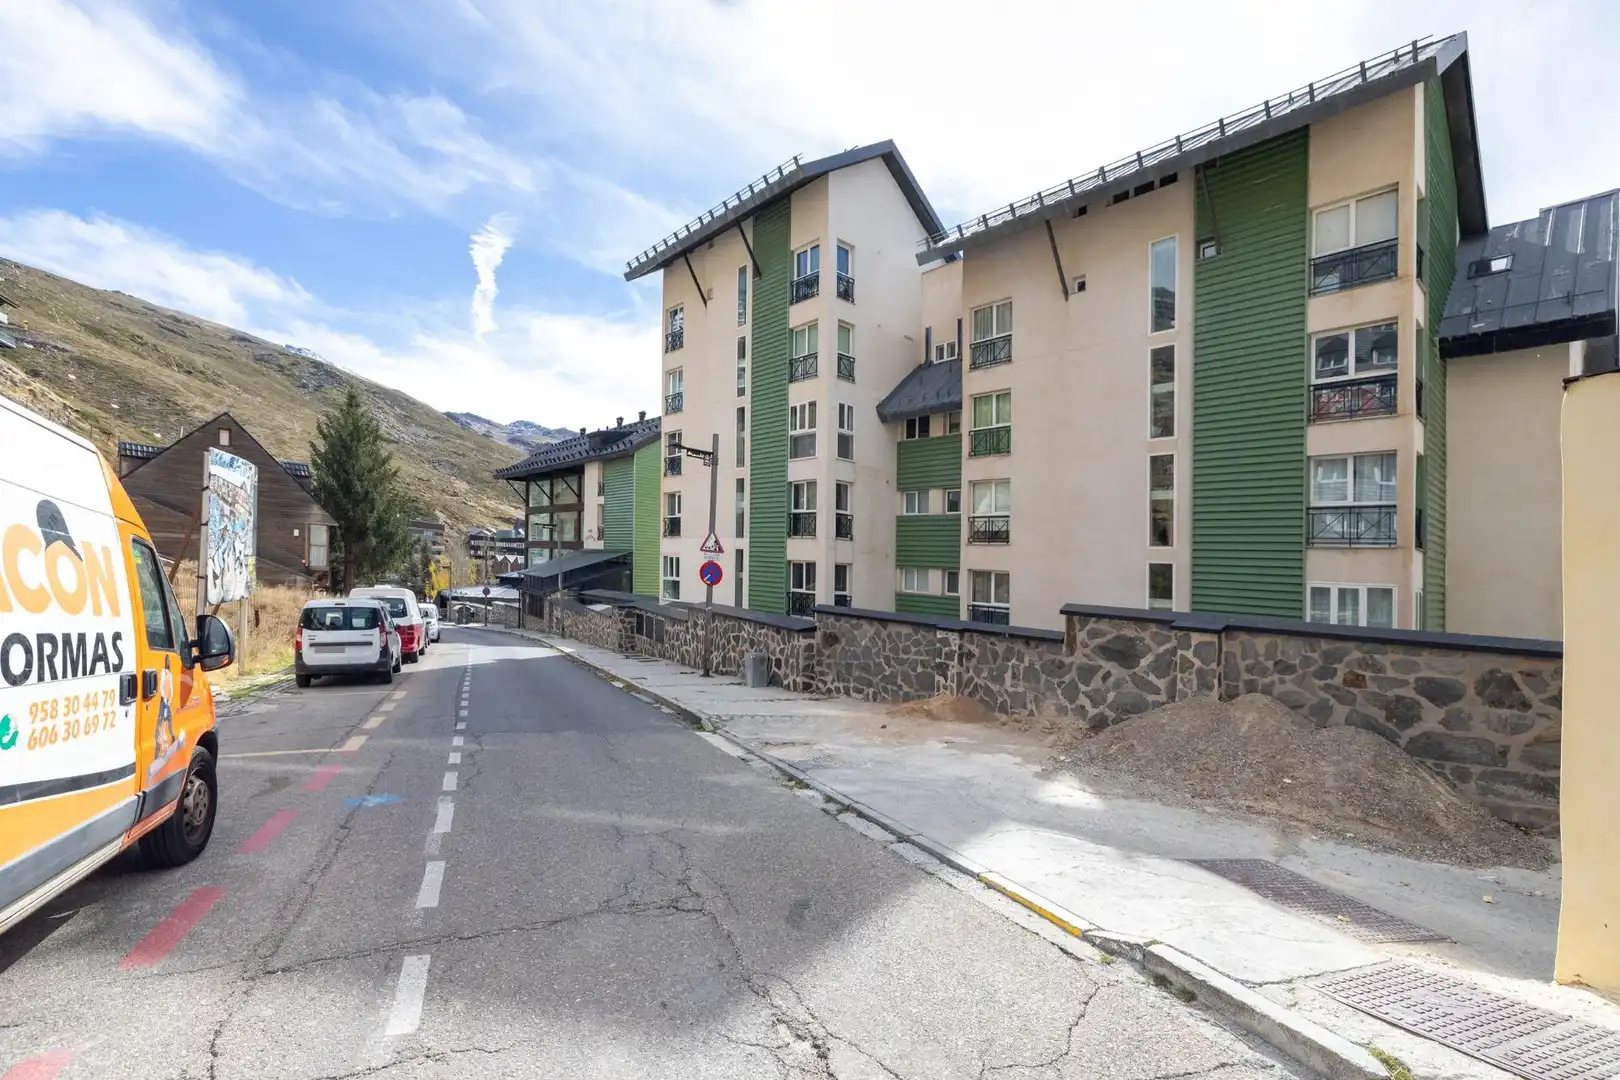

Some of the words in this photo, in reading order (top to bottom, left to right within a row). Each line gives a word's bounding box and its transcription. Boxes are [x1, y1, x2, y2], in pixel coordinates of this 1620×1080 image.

[0, 631, 124, 687] ORMAS
[29, 698, 59, 725] 958
[63, 695, 80, 717] 30
[83, 691, 99, 713] 44
[102, 688, 117, 709] 79
[27, 724, 58, 751] 606
[62, 718, 80, 742] 30
[84, 714, 100, 736] 69
[102, 710, 117, 731] 72
